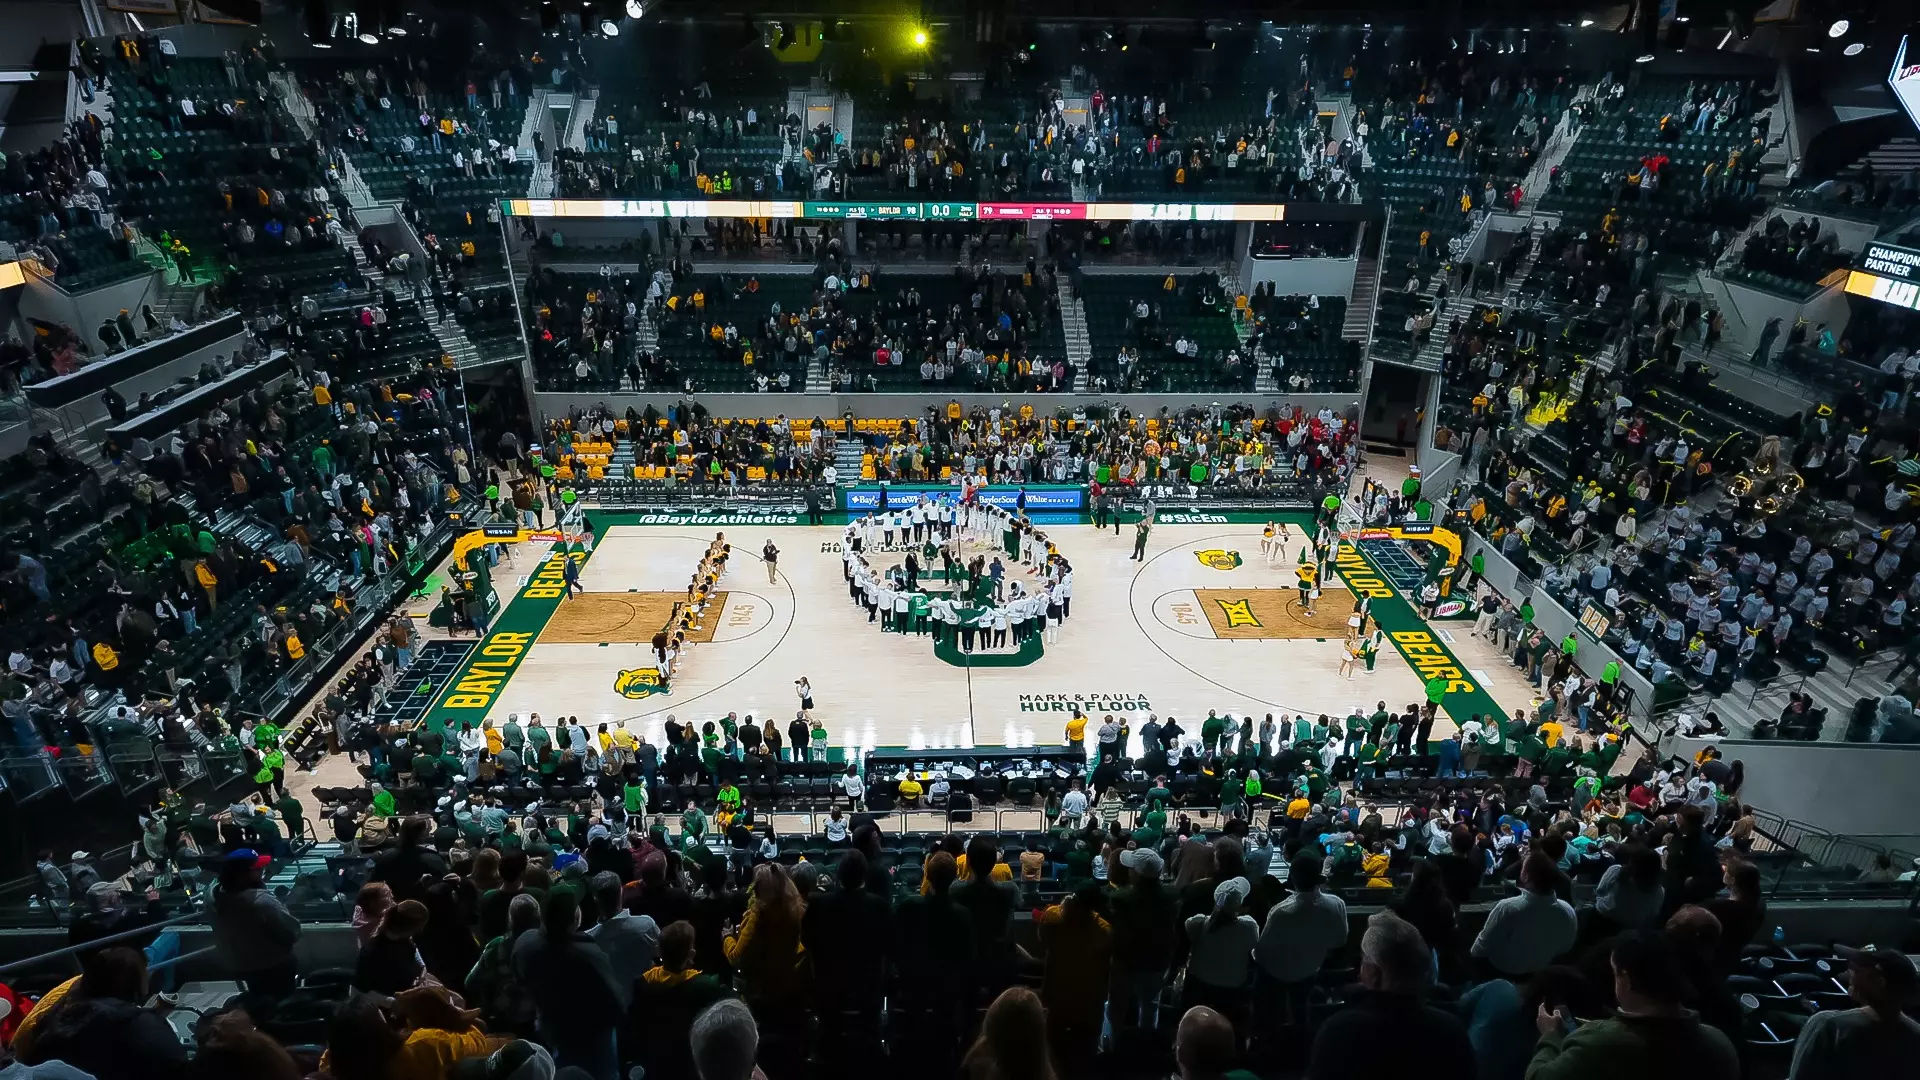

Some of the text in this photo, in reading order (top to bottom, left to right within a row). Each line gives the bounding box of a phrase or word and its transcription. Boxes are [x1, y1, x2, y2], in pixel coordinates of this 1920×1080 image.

[878, 206, 901, 215] BAYLOR
[906, 206, 917, 215] 98
[931, 204, 951, 217] 0.0
[982, 206, 993, 215] 79
[1868, 246, 1920, 267] CHAMPION
[1864, 257, 1911, 277] PARTNER
[639, 514, 798, 525] @BaylorAthletics
[1159, 513, 1229, 523] #SicEm
[728, 604, 755, 627] 1845
[1170, 602, 1198, 625] 1845
[1435, 603, 1463, 616] LIBMAN
[442, 632, 534, 708] BAYLOR
[1019, 693, 1148, 702] MARK & PAULA
[1020, 701, 1153, 712] HURD FLOOR
